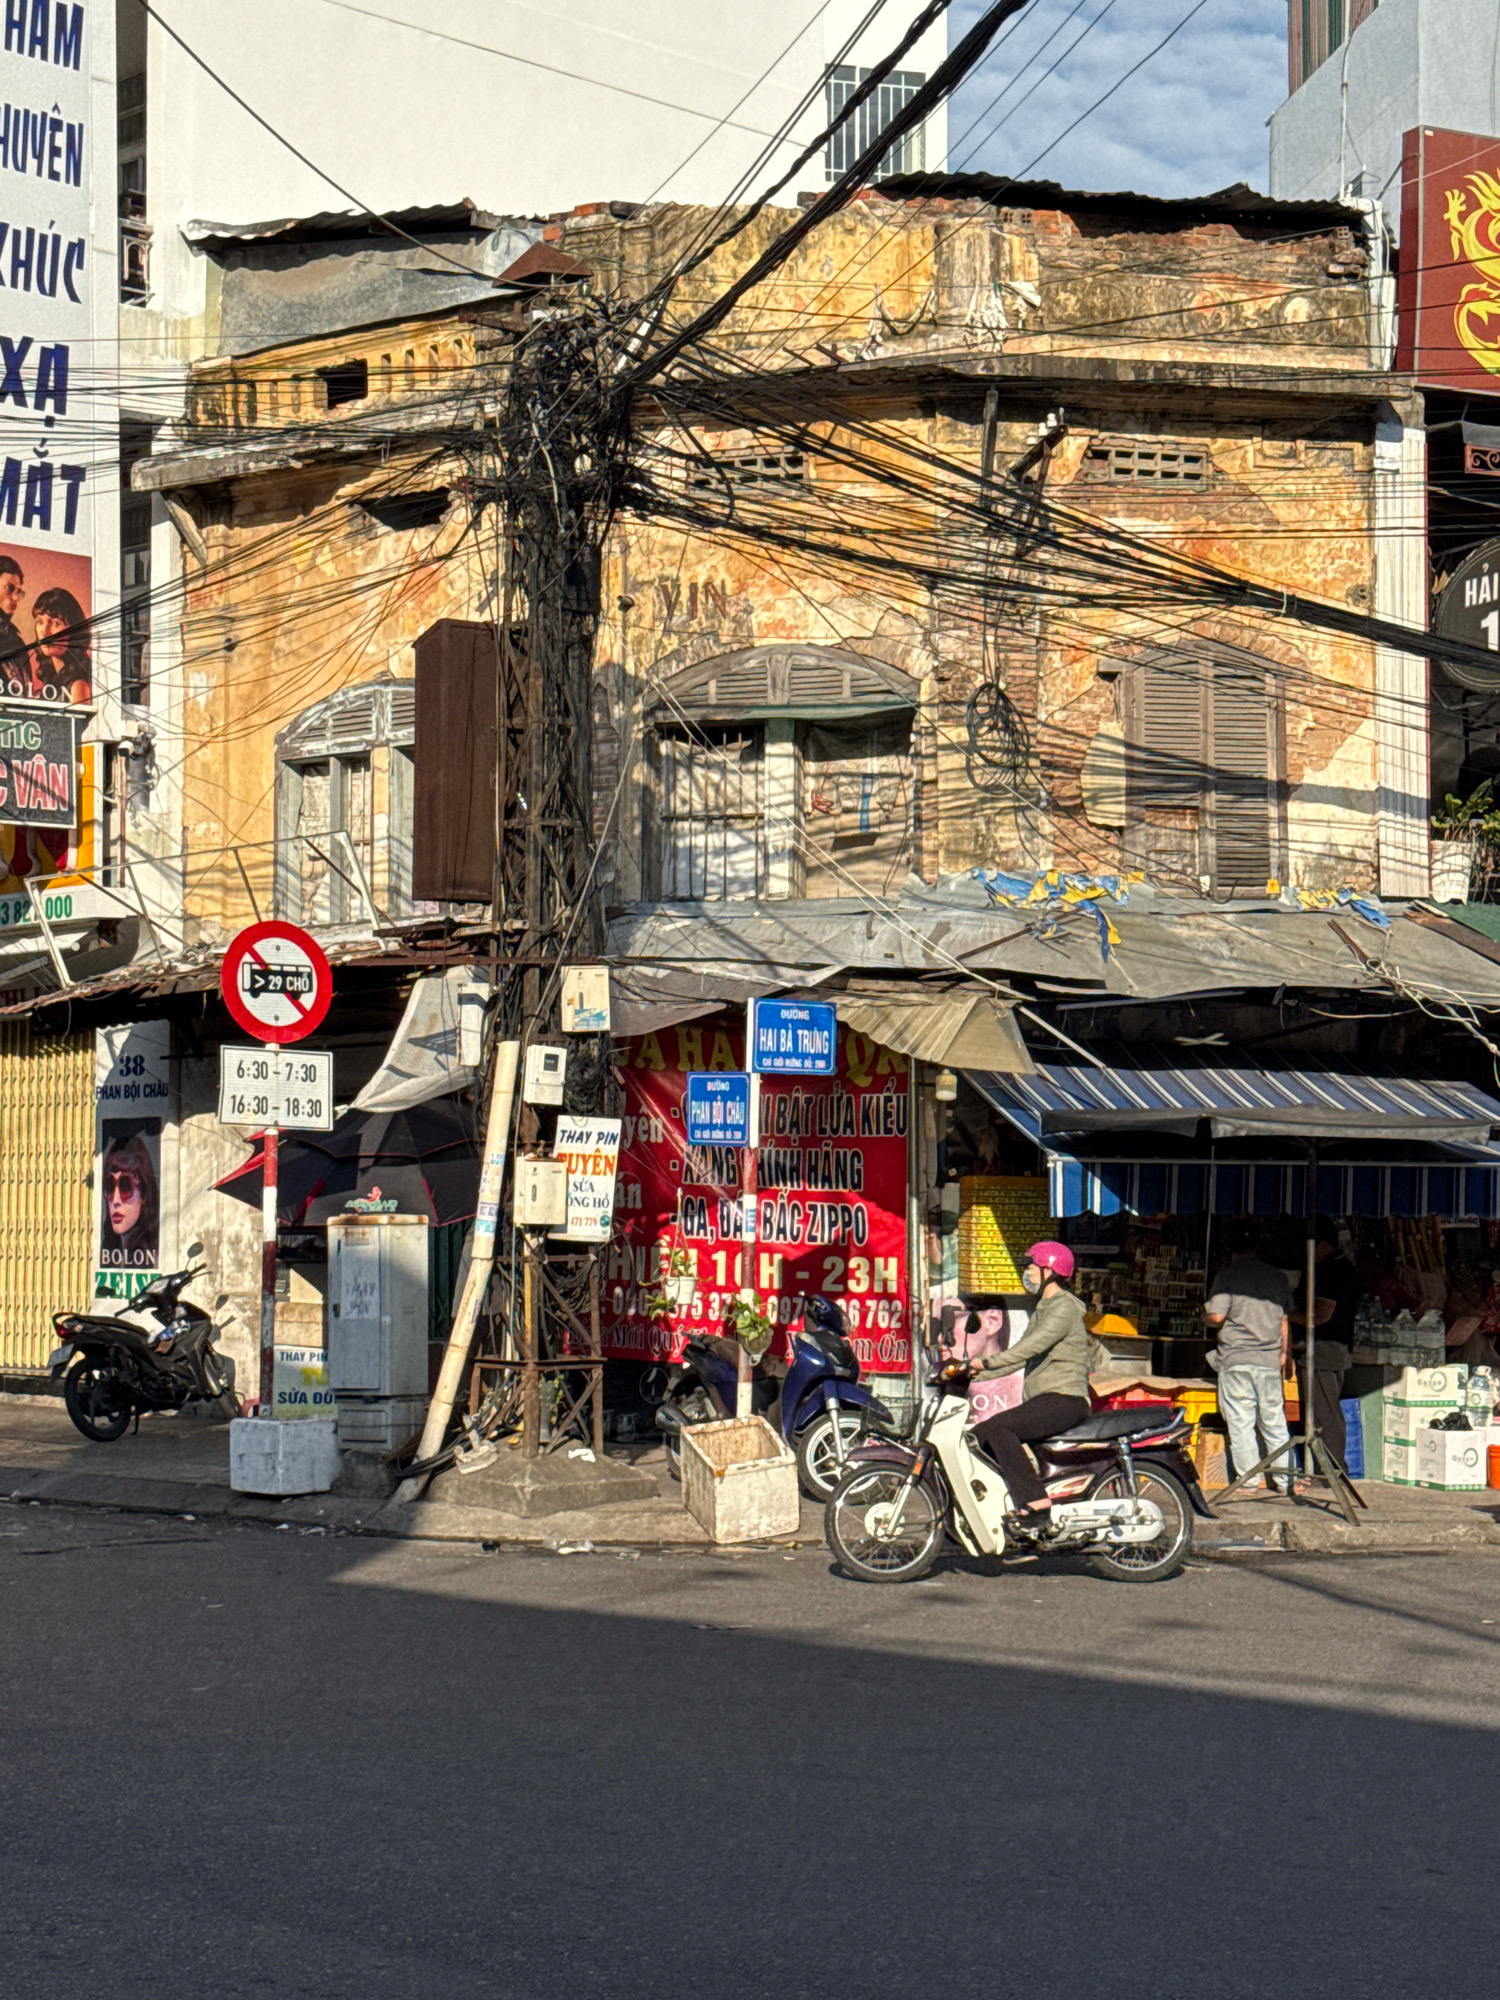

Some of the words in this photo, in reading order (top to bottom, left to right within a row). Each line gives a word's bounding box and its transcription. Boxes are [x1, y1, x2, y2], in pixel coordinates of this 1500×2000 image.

[11, 753, 69, 811] VÂN
[268, 975, 283, 991] 29
[760, 1027, 777, 1052] HAI
[780, 1022, 793, 1052] BÀ
[119, 1054, 145, 1077] 38
[237, 1059, 269, 1081] 6:30
[285, 1062, 317, 1083] 7:30
[95, 1085, 121, 1100] PHAN
[230, 1094, 269, 1116] 16:30
[285, 1097, 322, 1118] 18:30
[560, 1129, 592, 1145] THAY
[596, 1131, 619, 1146] PIN
[805, 1202, 868, 1246] ZIPPO
[101, 1248, 157, 1266] BOLON
[821, 1255, 898, 1294] 23H
[279, 1351, 306, 1362] THAY
[309, 1352, 328, 1362] PIN
[278, 1387, 308, 1405] SỬA
